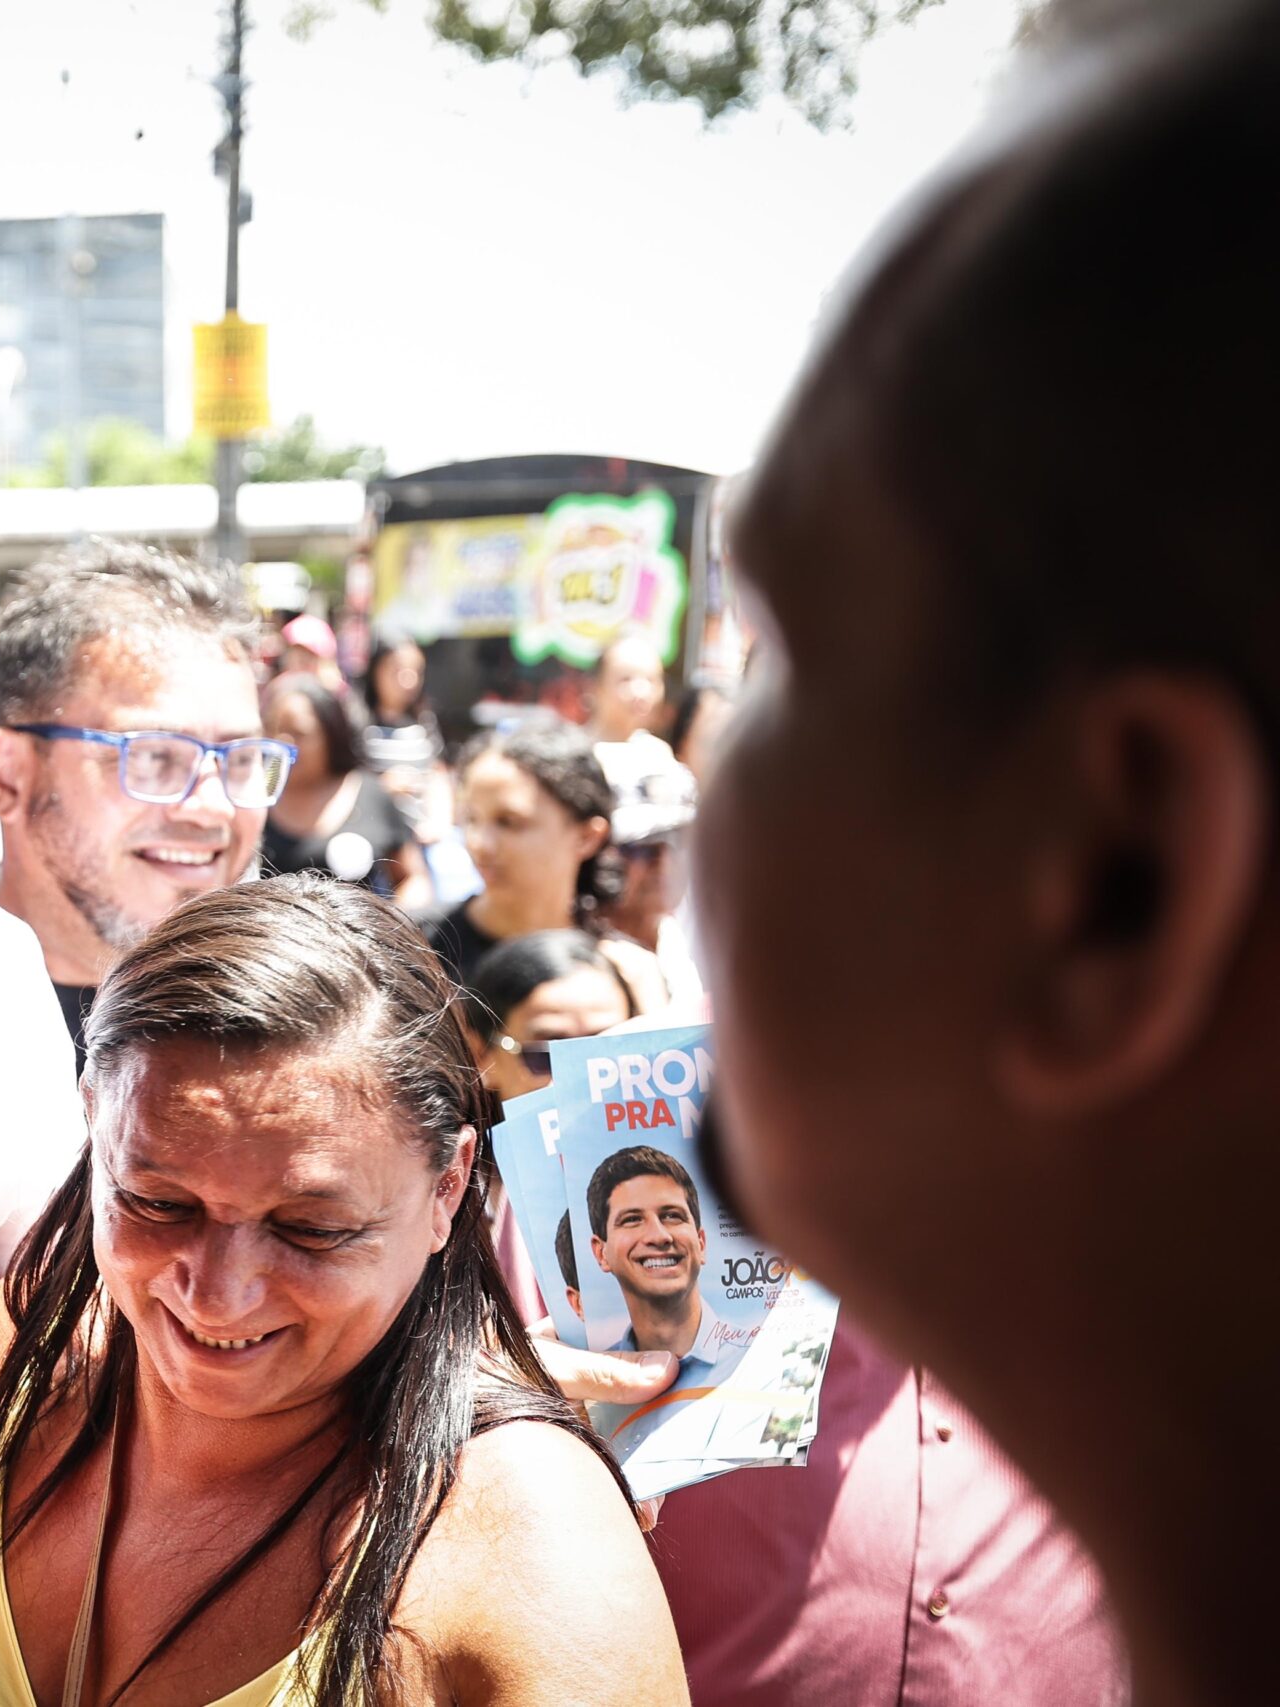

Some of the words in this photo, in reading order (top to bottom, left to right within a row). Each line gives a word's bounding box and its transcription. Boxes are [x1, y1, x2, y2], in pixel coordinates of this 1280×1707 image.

[605, 1098, 676, 1132] PRA
[721, 1251, 785, 1287] JOÃO
[726, 1287, 764, 1300] CAMPOS
